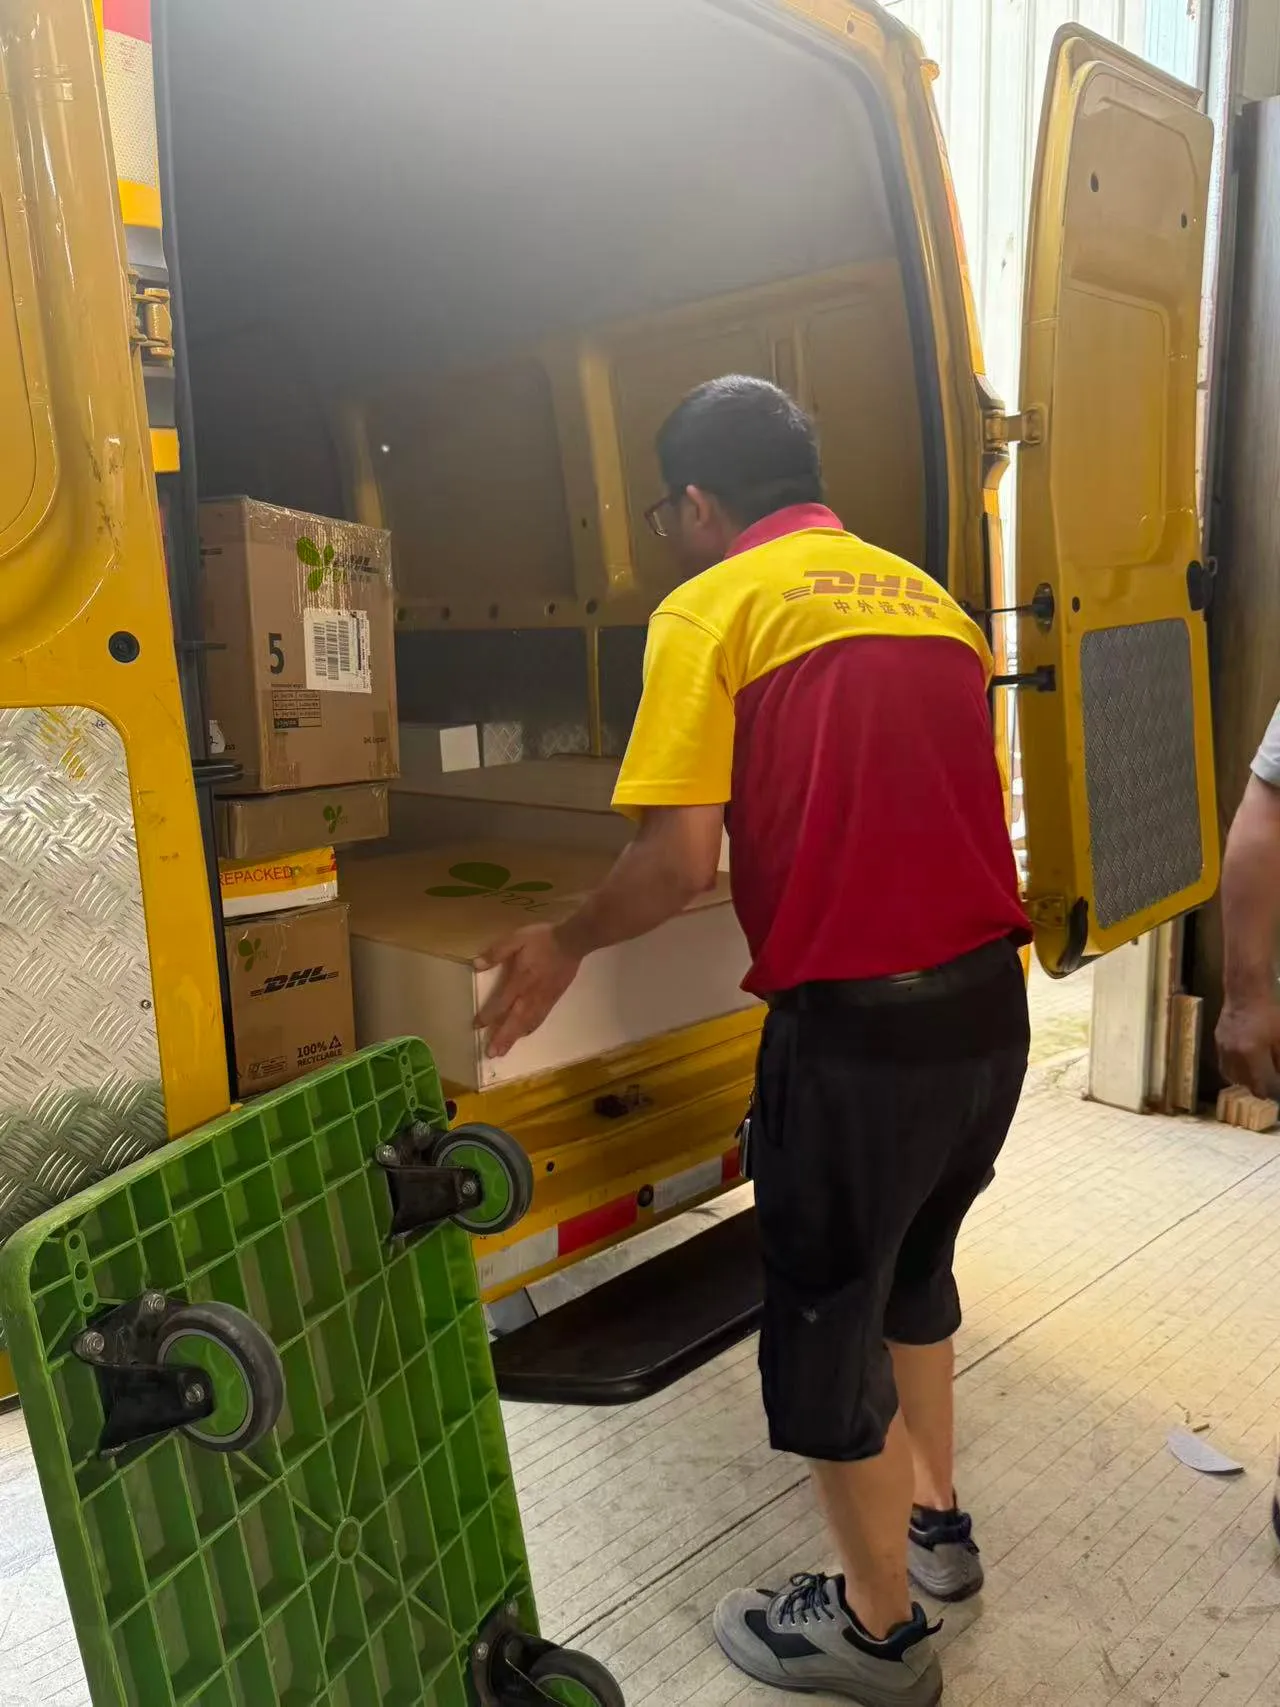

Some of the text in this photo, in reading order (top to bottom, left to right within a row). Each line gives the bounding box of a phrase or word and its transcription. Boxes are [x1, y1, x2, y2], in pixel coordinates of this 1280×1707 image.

[804, 570, 940, 605] DHL
[268, 632, 286, 676] 5
[263, 965, 328, 994] DHL
[296, 1040, 328, 1059] 100%
[296, 1048, 343, 1069] RECYCLABLE
